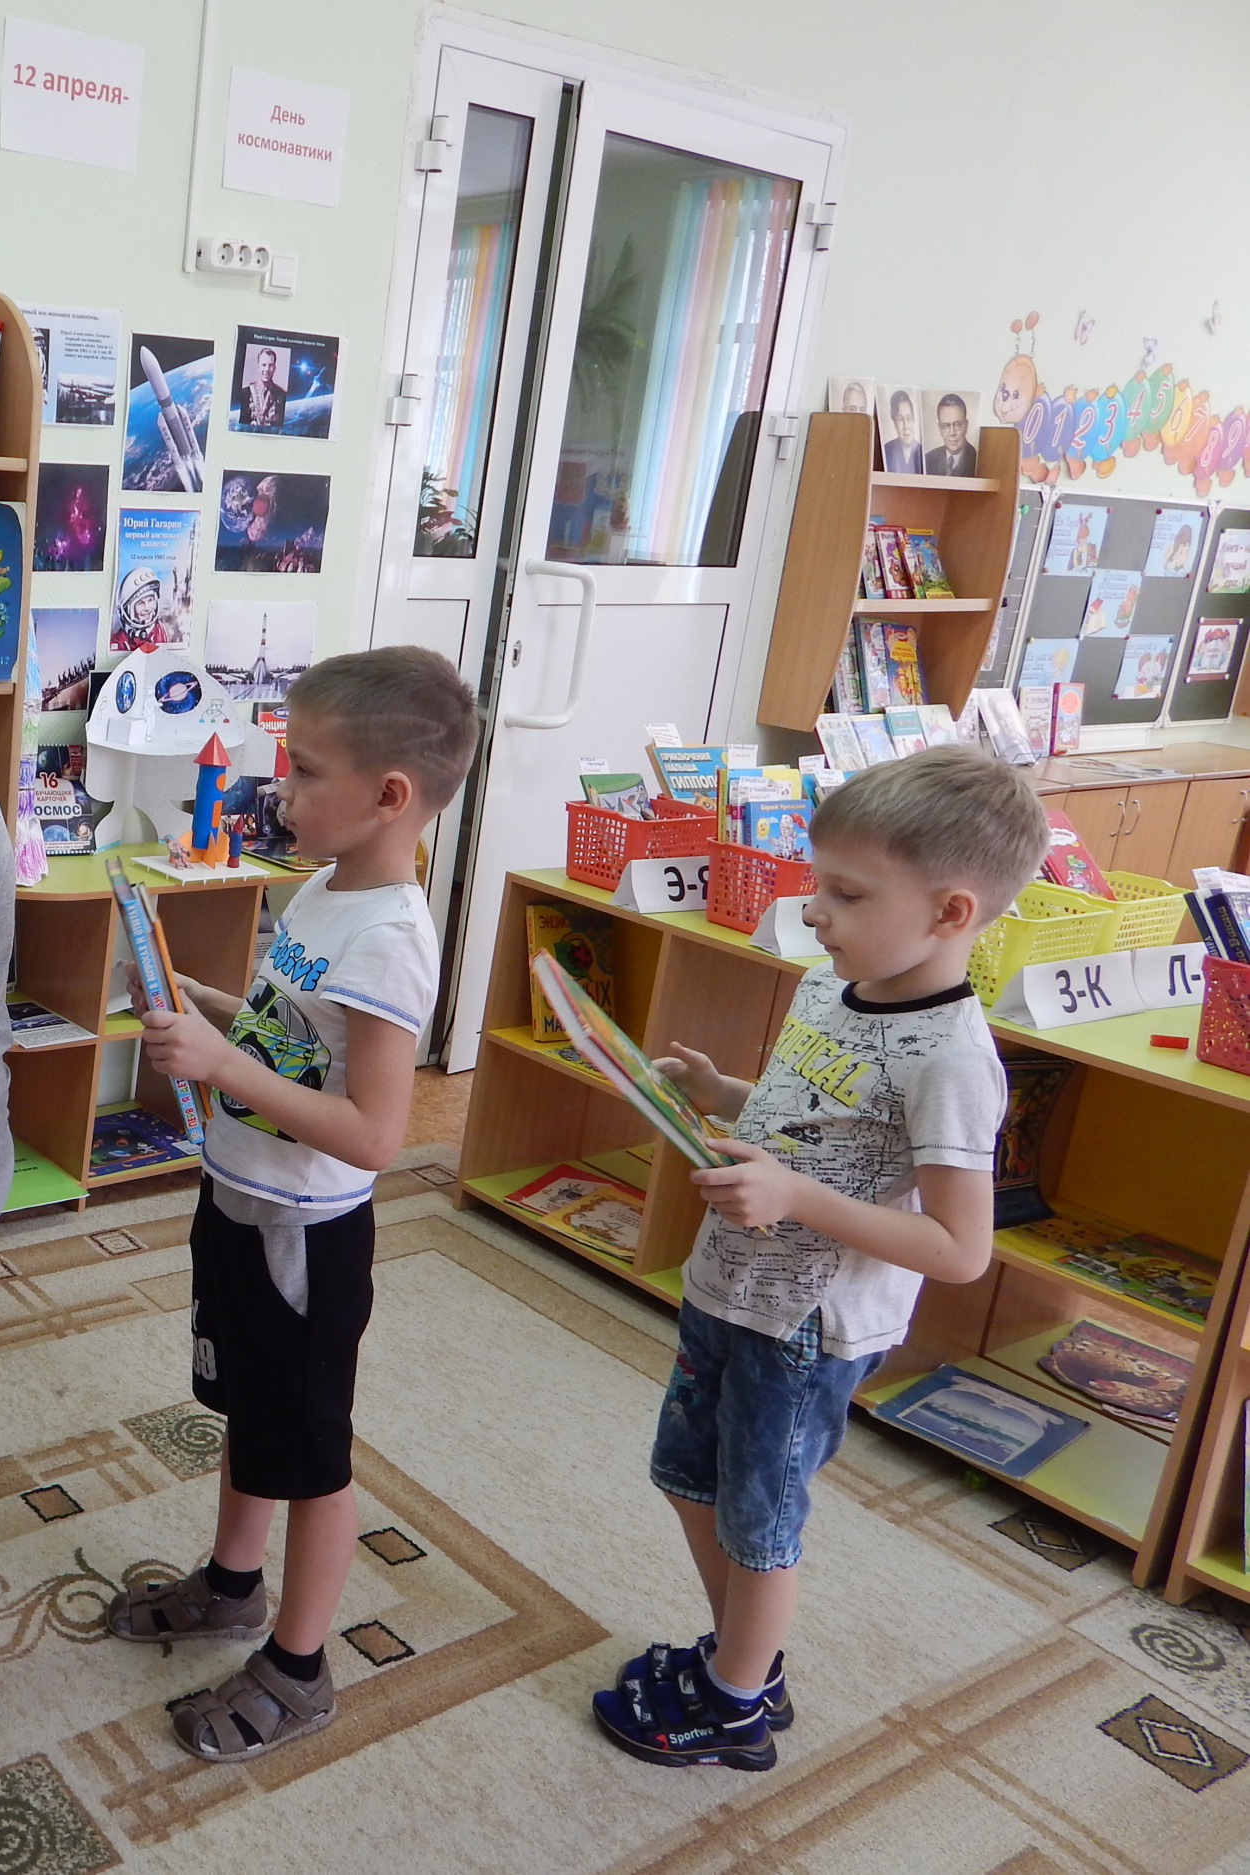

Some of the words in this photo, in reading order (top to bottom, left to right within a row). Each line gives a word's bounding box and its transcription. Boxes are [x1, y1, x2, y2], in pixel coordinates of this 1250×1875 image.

[13, 63, 36, 88] 12
[43, 70, 130, 105] апреля-
[271, 104, 306, 126] День
[237, 132, 332, 162] космонавтики
[1023, 402, 1044, 444] 0
[1051, 407, 1068, 447] 1
[1071, 406, 1095, 449] 2
[1099, 402, 1117, 444] 3
[1127, 388, 1146, 425] 4
[1150, 380, 1169, 417] 5
[1170, 395, 1189, 433] 6
[1184, 405, 1207, 442] 7
[1200, 427, 1219, 467] 8
[1222, 420, 1243, 459] 9
[123, 517, 149, 530] Юрий
[150, 518, 182, 530] Гагарин
[40, 773, 59, 789] 16
[34, 805, 81, 816] ОСМОС
[1056, 965, 1112, 1013] З-К
